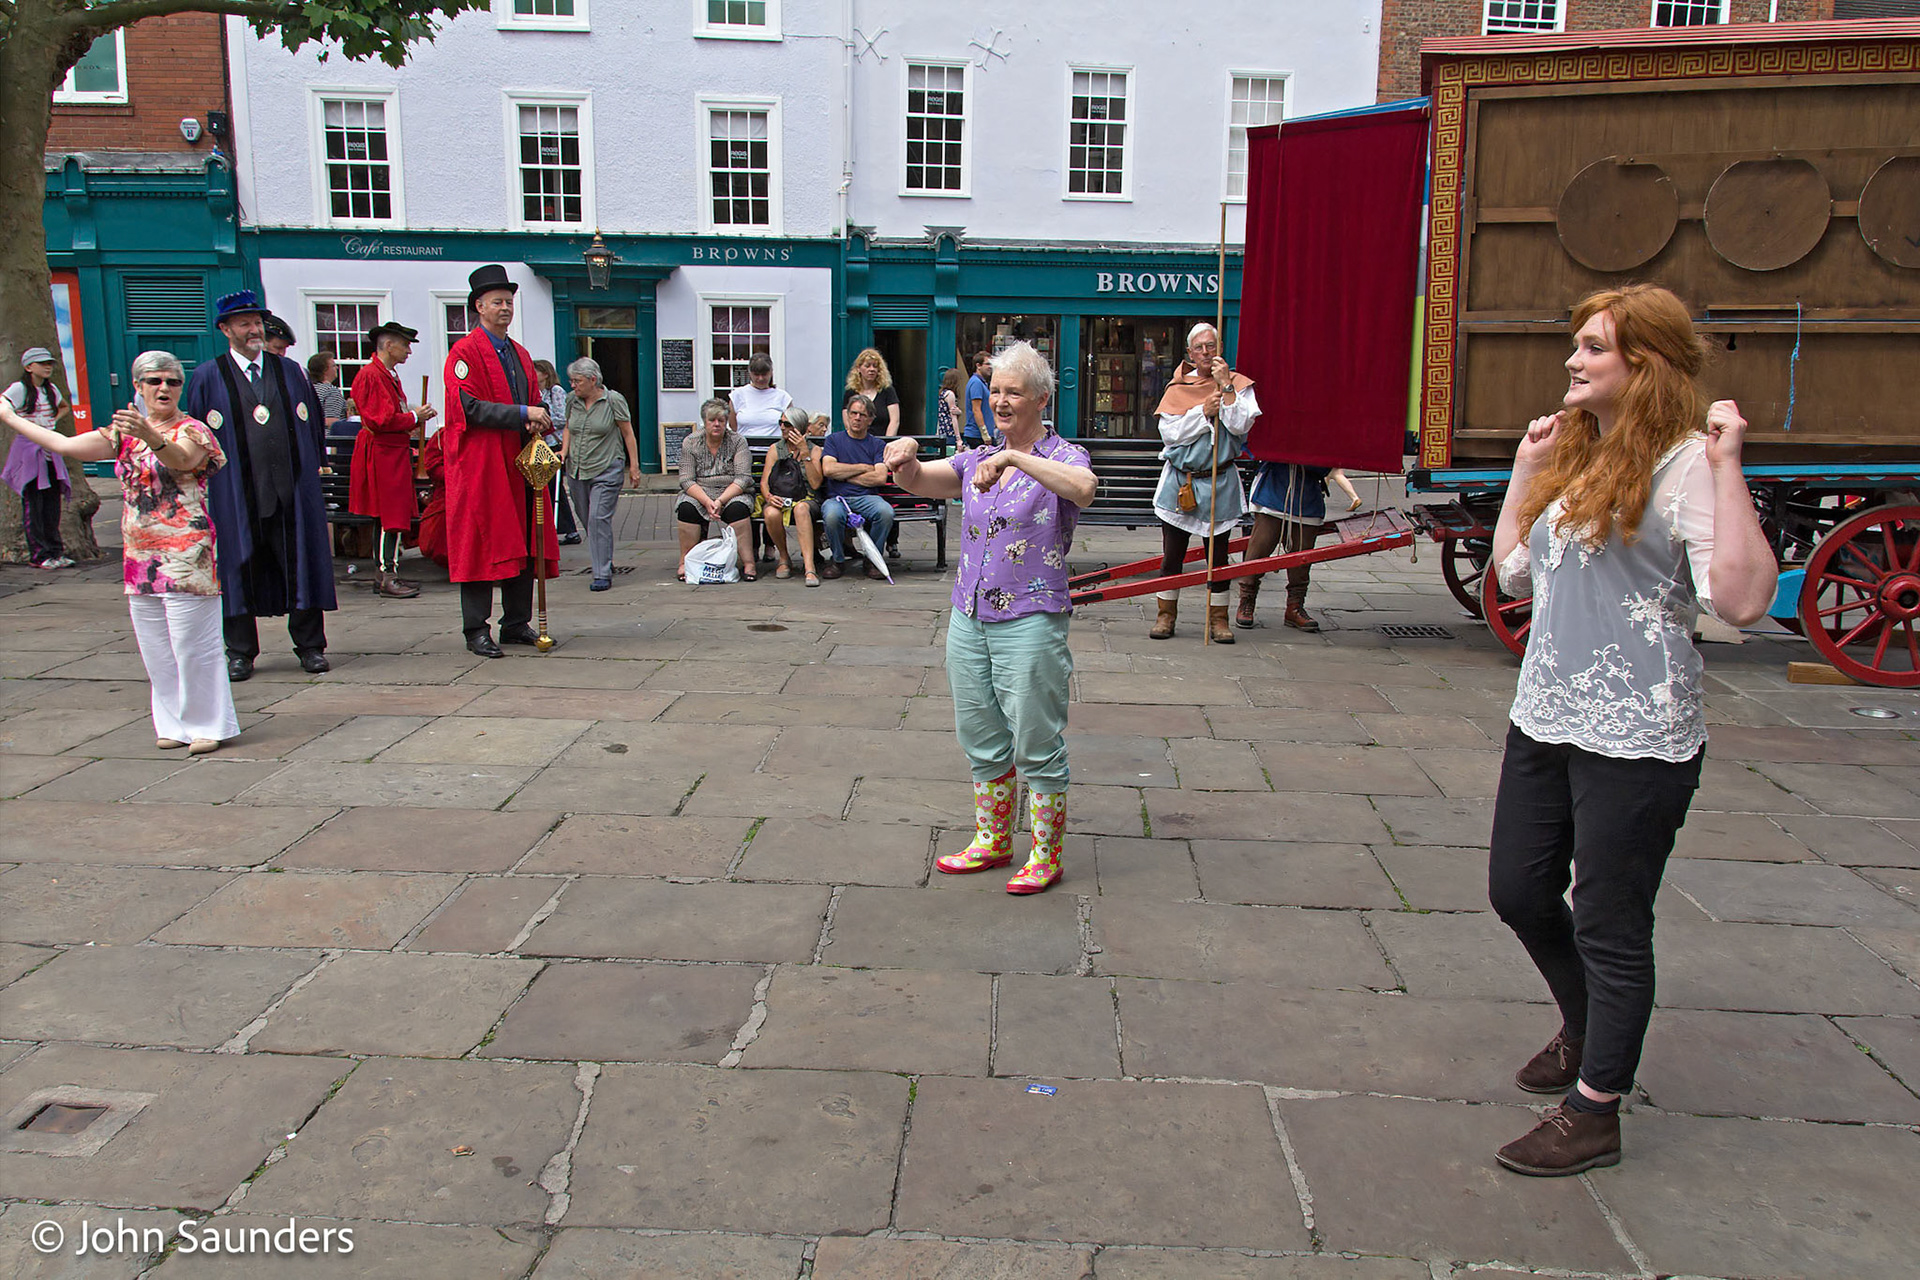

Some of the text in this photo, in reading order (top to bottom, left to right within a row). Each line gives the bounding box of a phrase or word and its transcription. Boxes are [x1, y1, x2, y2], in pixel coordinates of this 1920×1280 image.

[341, 235, 444, 259] Café RESTAURANT
[692, 247, 790, 261] BROWNS
[1096, 272, 1219, 294] BROWNS
